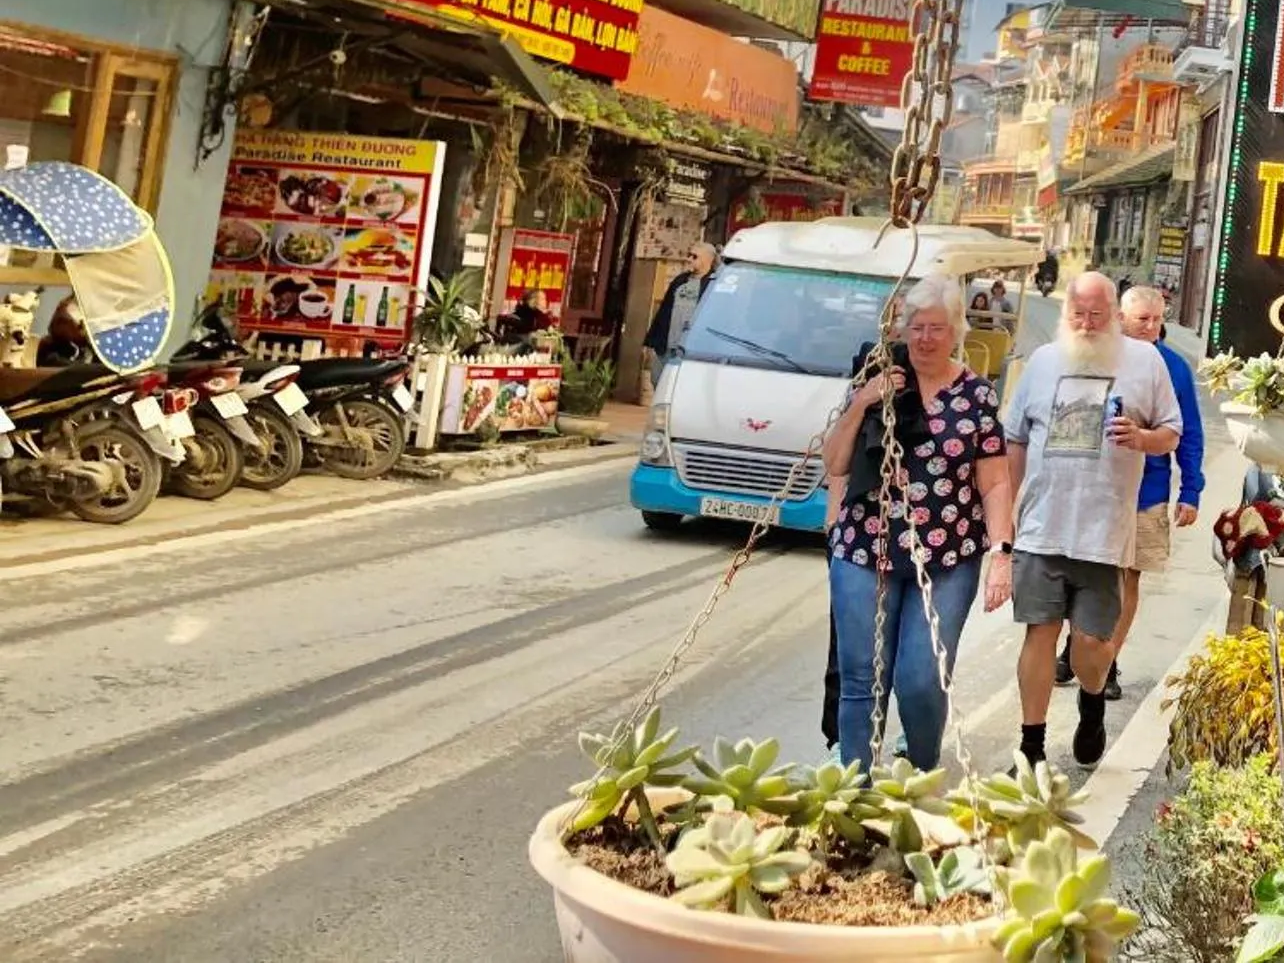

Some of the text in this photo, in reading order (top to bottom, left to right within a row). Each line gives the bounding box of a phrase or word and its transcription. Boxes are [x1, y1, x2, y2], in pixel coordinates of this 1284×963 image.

[821, 16, 910, 43] RESTAURAN
[838, 53, 891, 76] COFFEE
[312, 151, 402, 169] Restaurant
